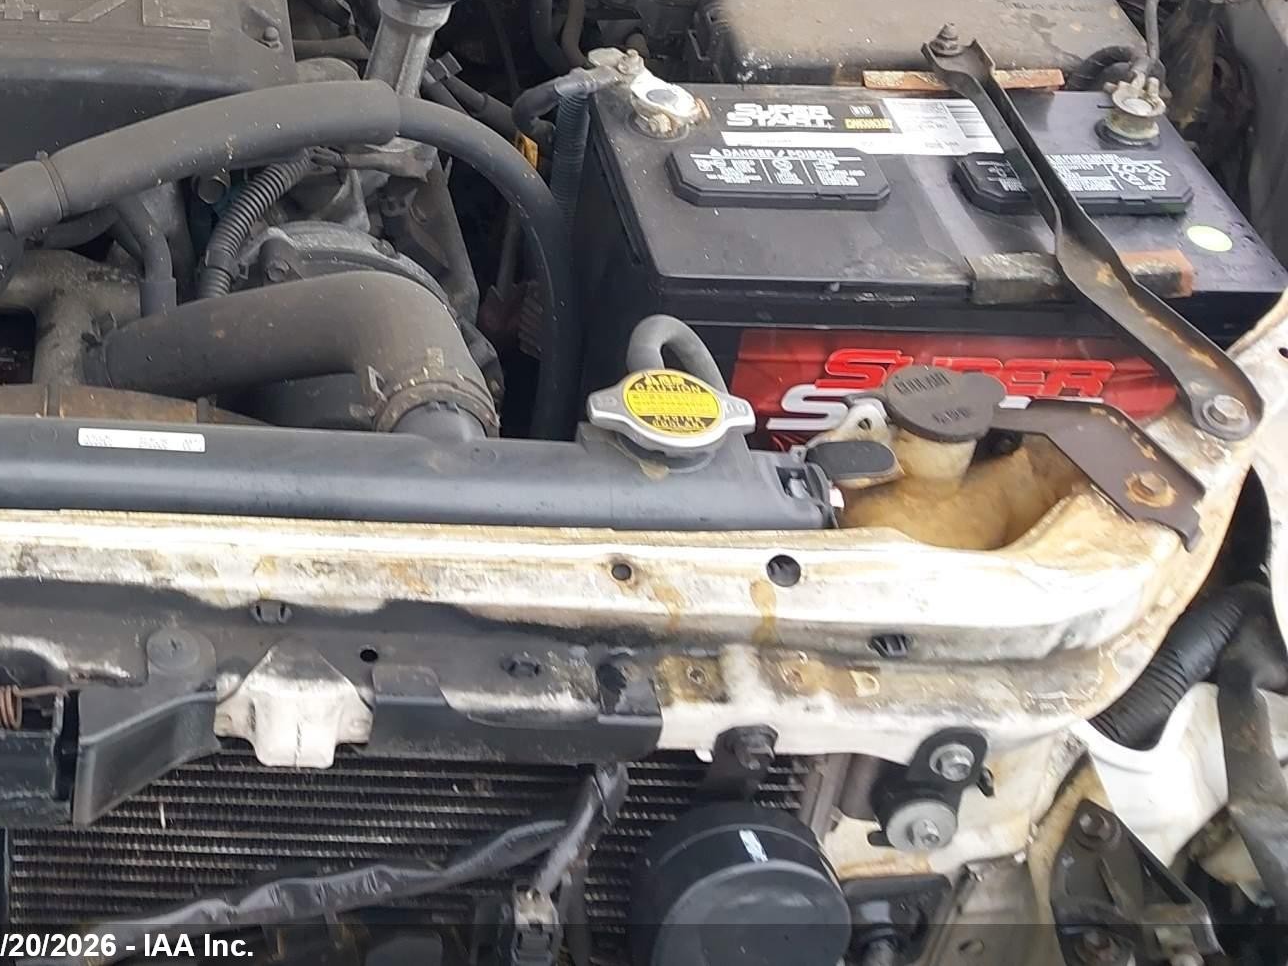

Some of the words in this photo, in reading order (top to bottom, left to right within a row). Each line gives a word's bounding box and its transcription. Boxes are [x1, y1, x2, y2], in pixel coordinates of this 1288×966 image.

[733, 103, 831, 117] SUPER
[726, 112, 830, 128] START
[722, 149, 777, 158] DANGER
[786, 150, 837, 159] POISON
[634, 383, 703, 393] CAUTION
